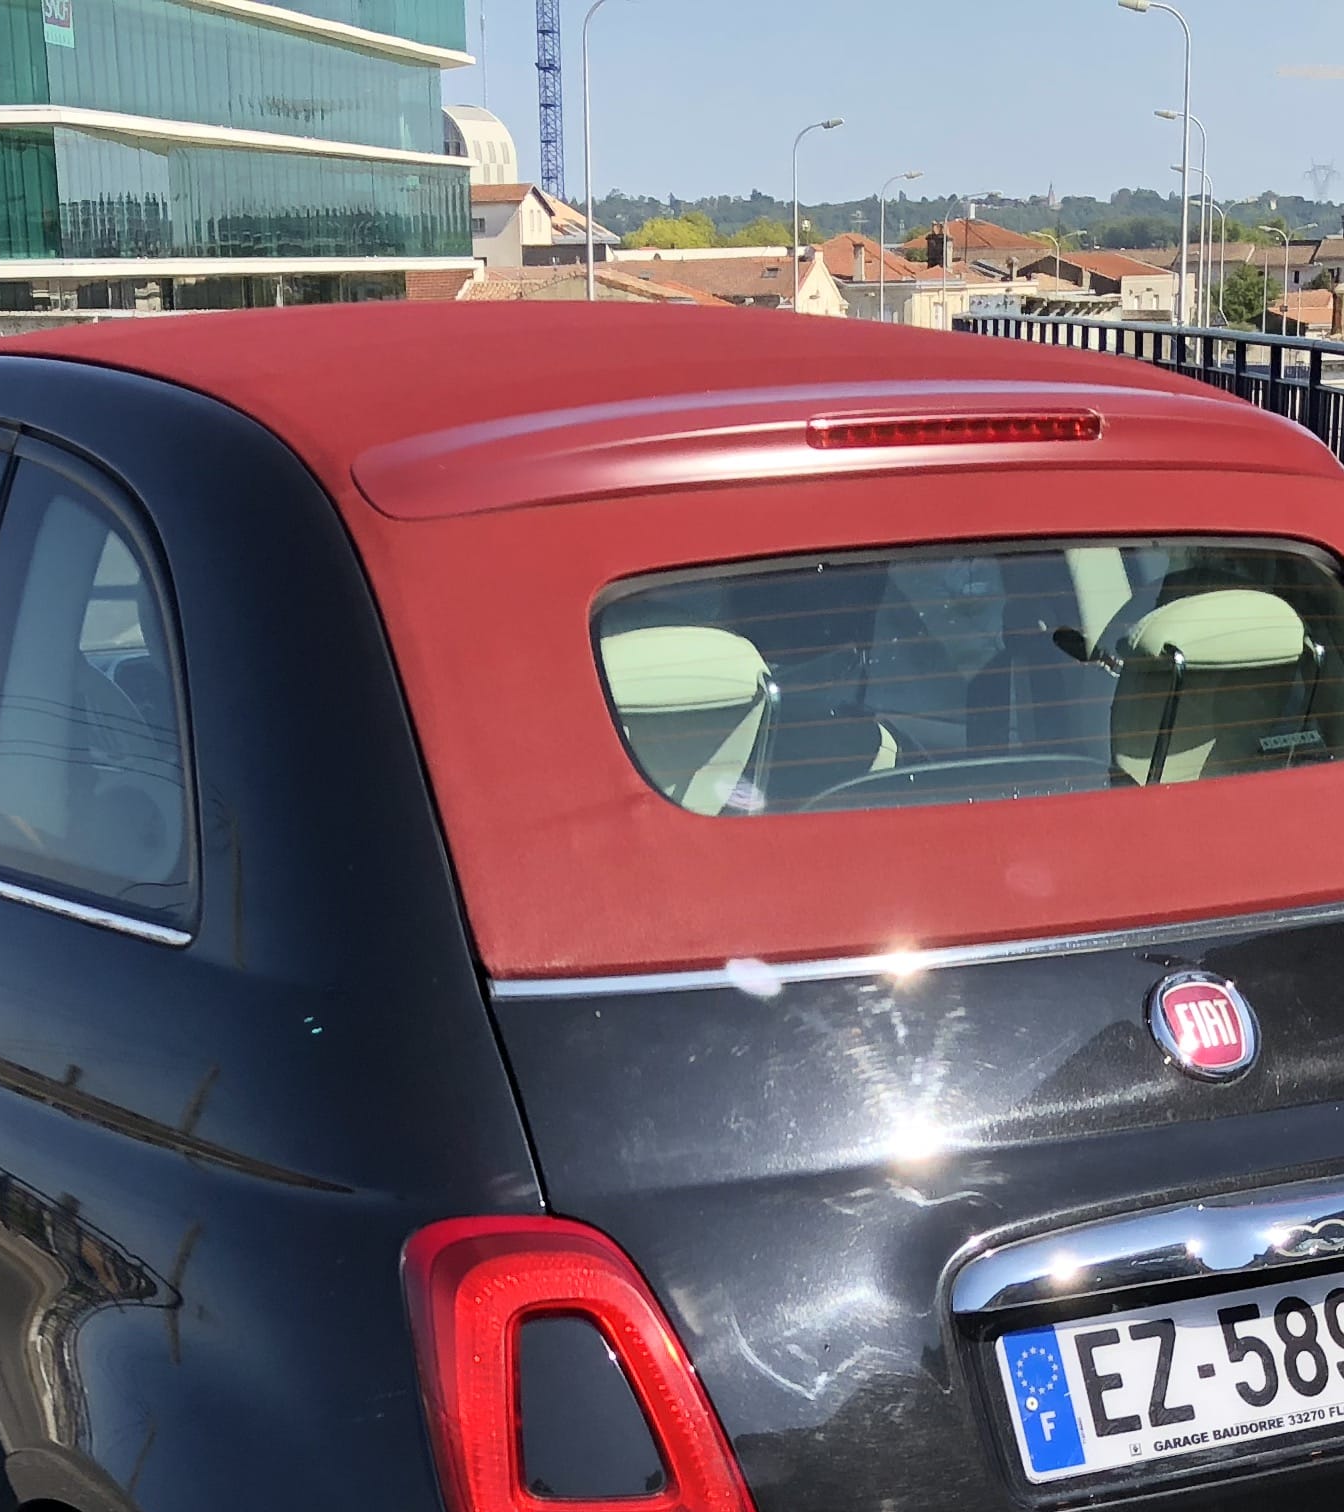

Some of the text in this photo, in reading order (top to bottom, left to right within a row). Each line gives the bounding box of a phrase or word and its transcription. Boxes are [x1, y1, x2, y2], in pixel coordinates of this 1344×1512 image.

[1174, 998, 1238, 1050] FIAT
[1039, 1410, 1057, 1442] F
[1154, 1431, 1210, 1452] GARAGE
[1212, 1417, 1285, 1441] BAUDORRE
[1288, 1408, 1326, 1426] 33270
